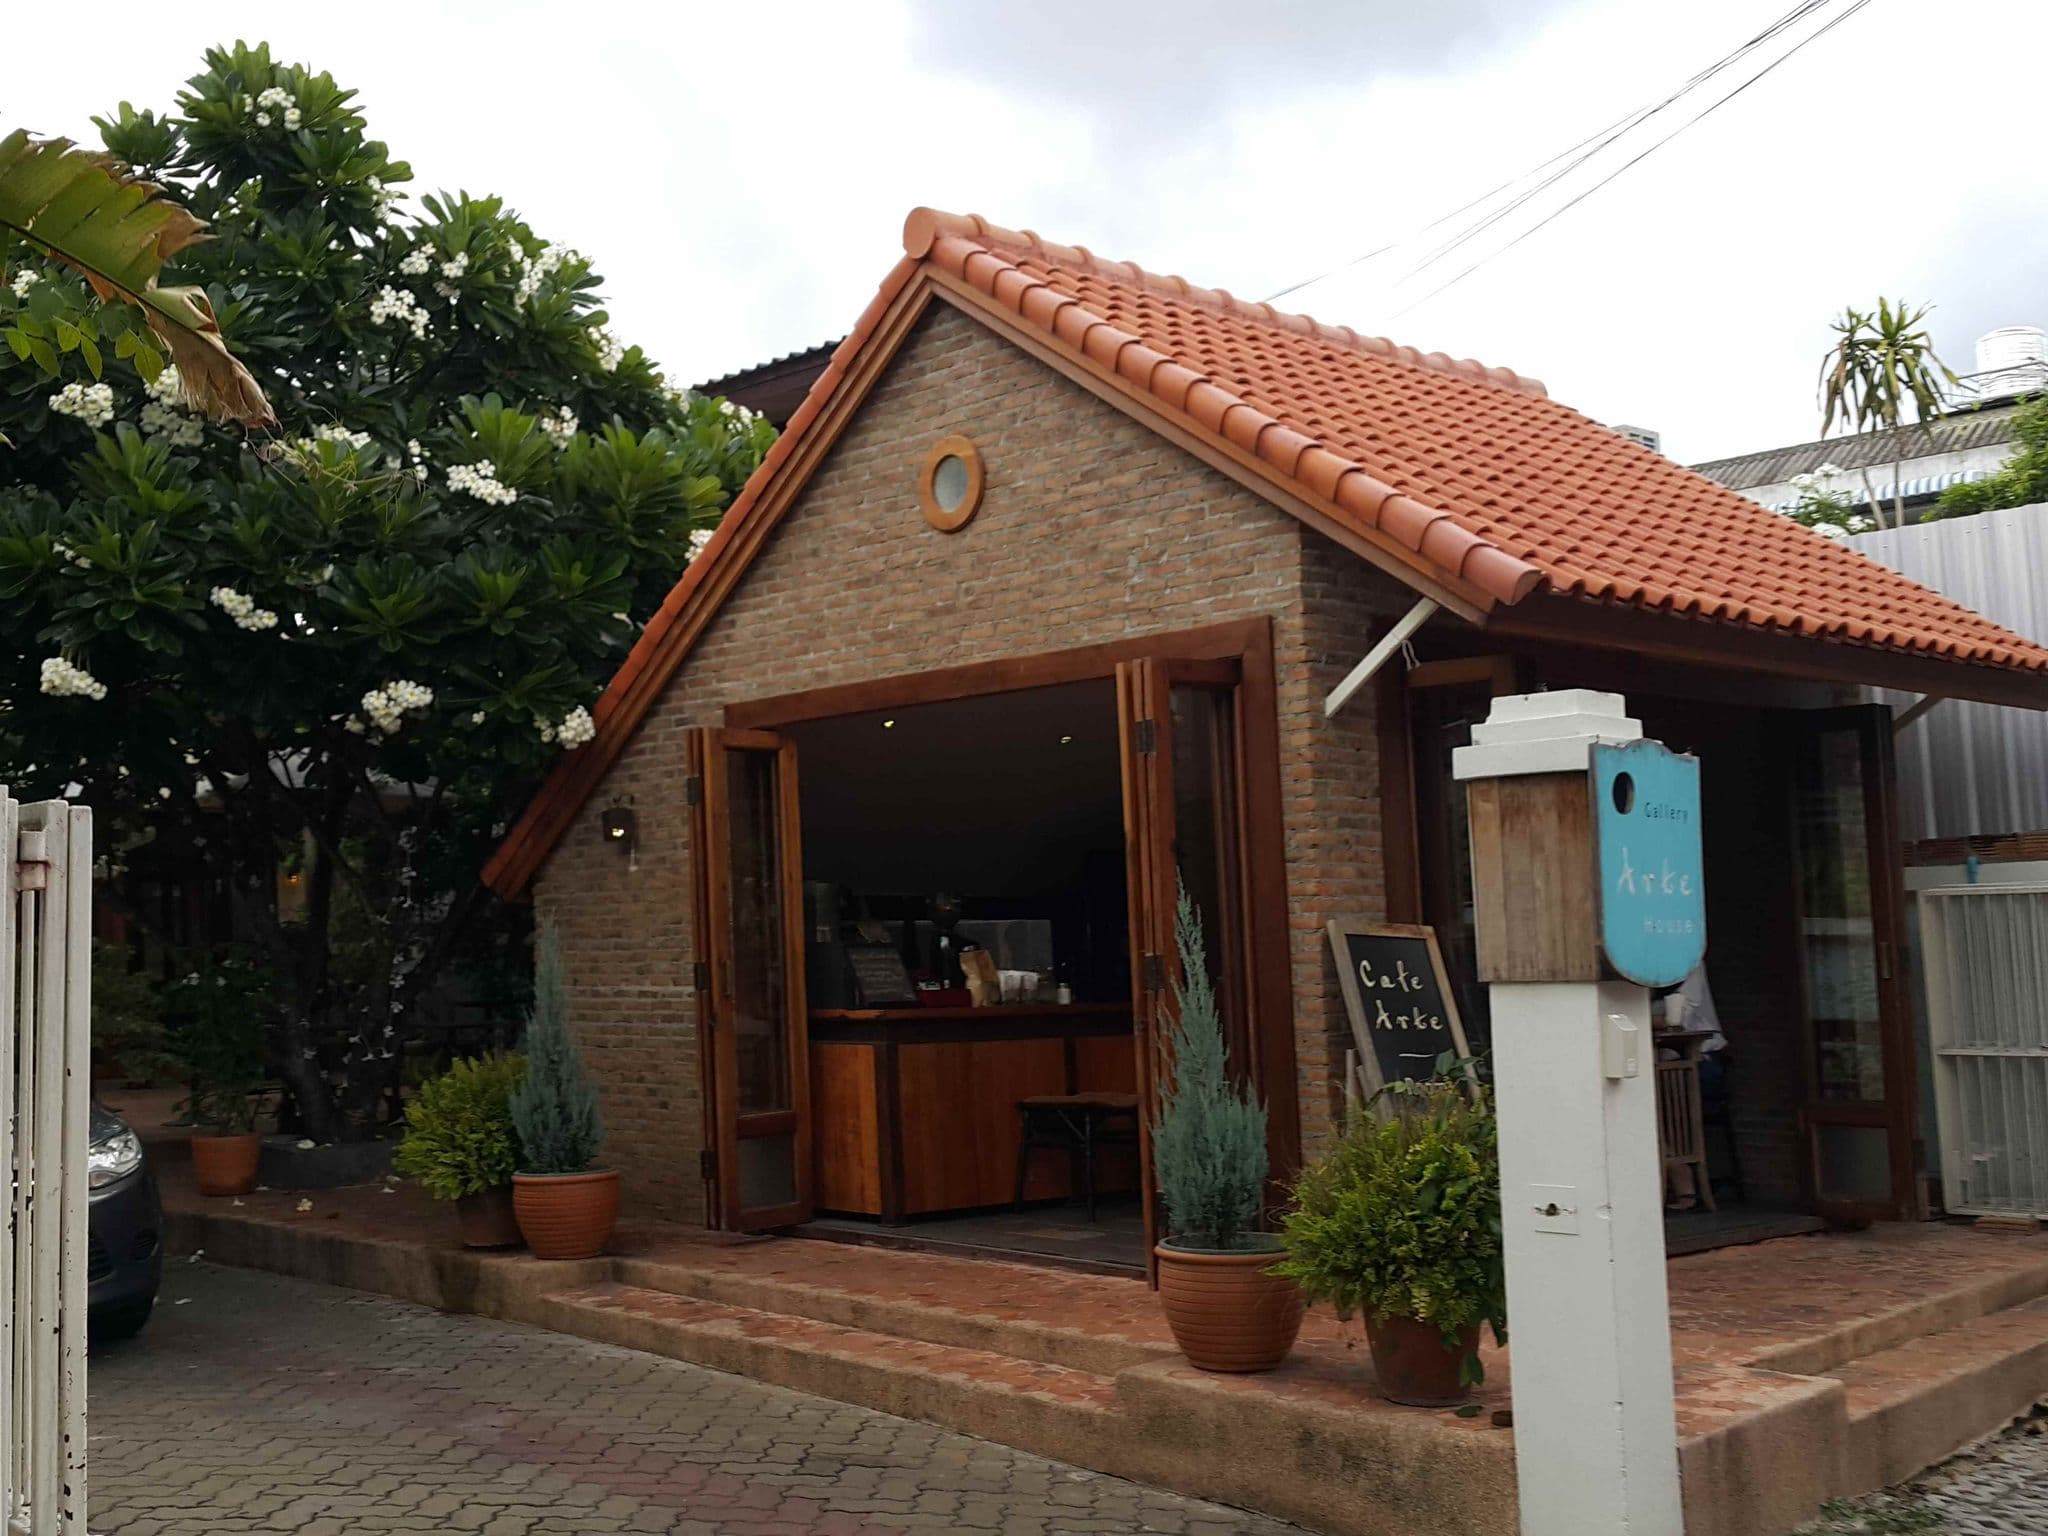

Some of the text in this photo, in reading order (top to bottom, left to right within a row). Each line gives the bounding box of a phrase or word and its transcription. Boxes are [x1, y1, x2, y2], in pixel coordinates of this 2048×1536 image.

[1644, 801, 1689, 824] Gallery
[1616, 847, 1693, 896] Arte
[1375, 999, 1444, 1031] Arte
